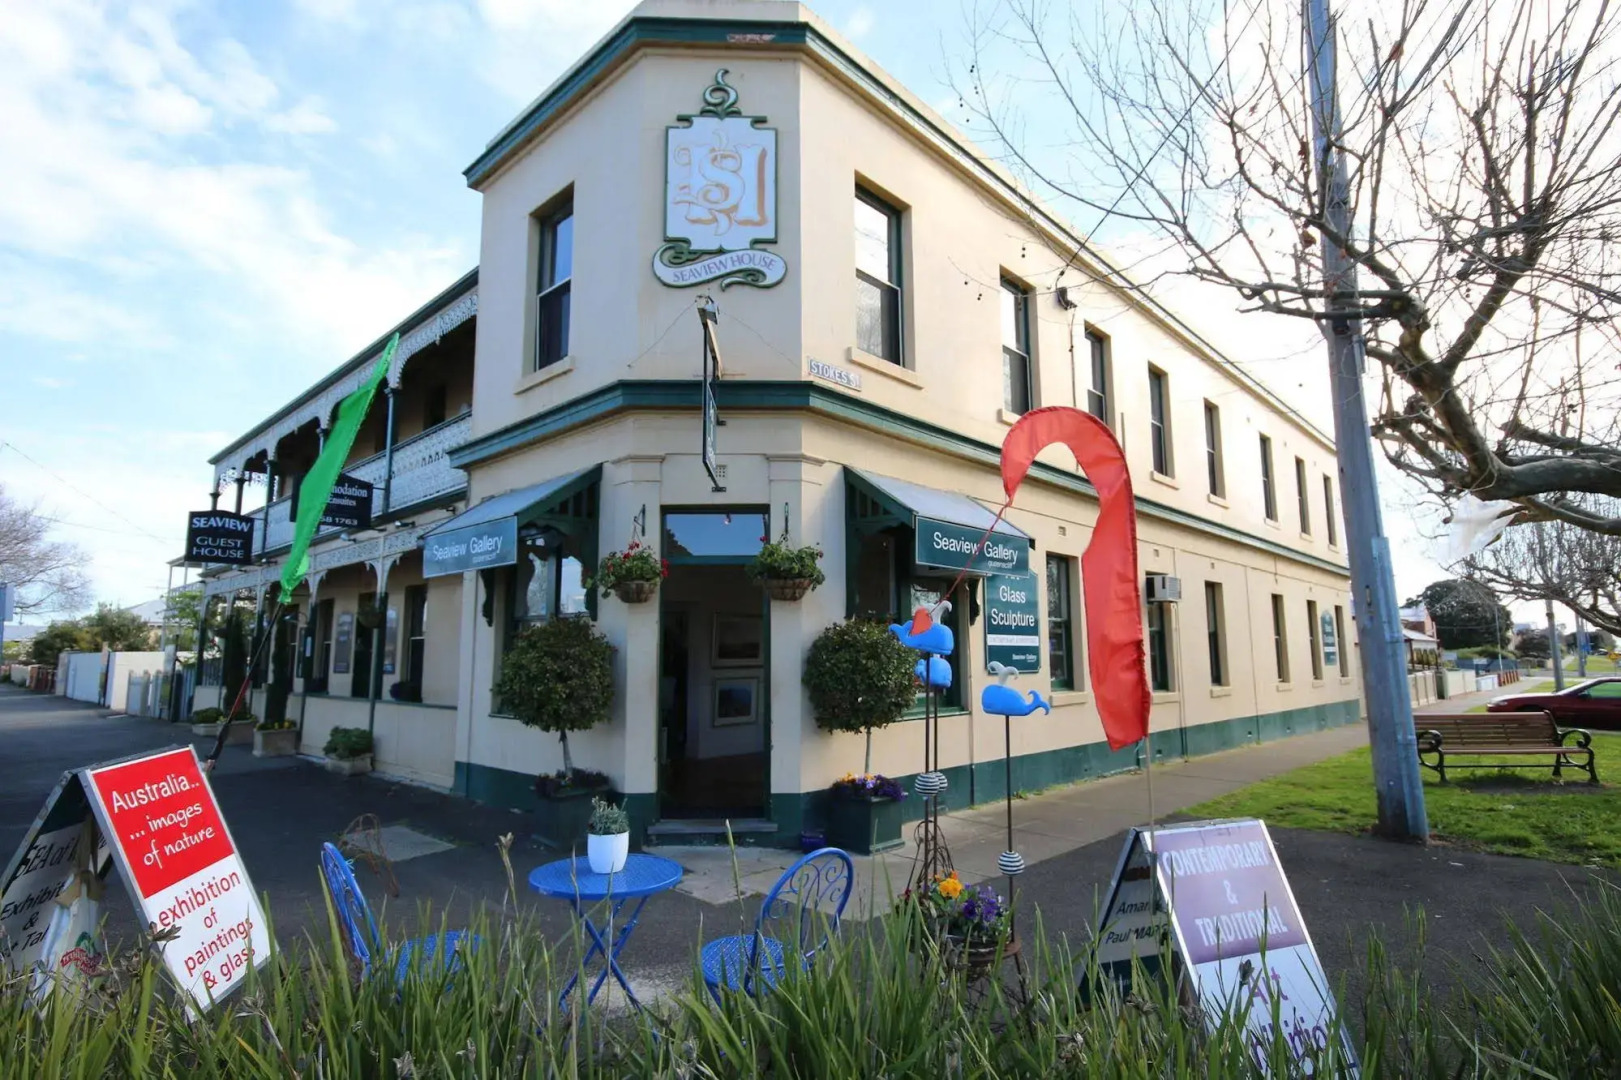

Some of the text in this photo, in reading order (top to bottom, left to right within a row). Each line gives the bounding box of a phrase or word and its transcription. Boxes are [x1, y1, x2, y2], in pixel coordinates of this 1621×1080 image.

[672, 252, 777, 282] SEAVIEW HOUSE
[811, 361, 848, 383] STOKES
[192, 516, 251, 532] SEAVIEW
[335, 517, 358, 526] 1763
[192, 547, 244, 558] HOUSE
[196, 536, 243, 548] GUEST
[433, 542, 468, 560] Seaview
[469, 534, 503, 554] Gallery
[933, 531, 1018, 565] Seaview Gallery
[999, 585, 1026, 604] Glass
[991, 608, 1035, 630] Sculpture
[145, 803, 203, 832] images
[143, 826, 216, 869] of nature
[1162, 841, 1270, 877] CONTEMPORARY
[1, 880, 65, 920] Exhibit
[158, 871, 241, 928] exhibition
[1223, 880, 1239, 905] &
[23, 911, 40, 931] &
[203, 907, 218, 929] of
[1195, 906, 1288, 946] TRADITIONAL
[1106, 928, 1132, 944] Paul
[202, 970, 218, 990] &
